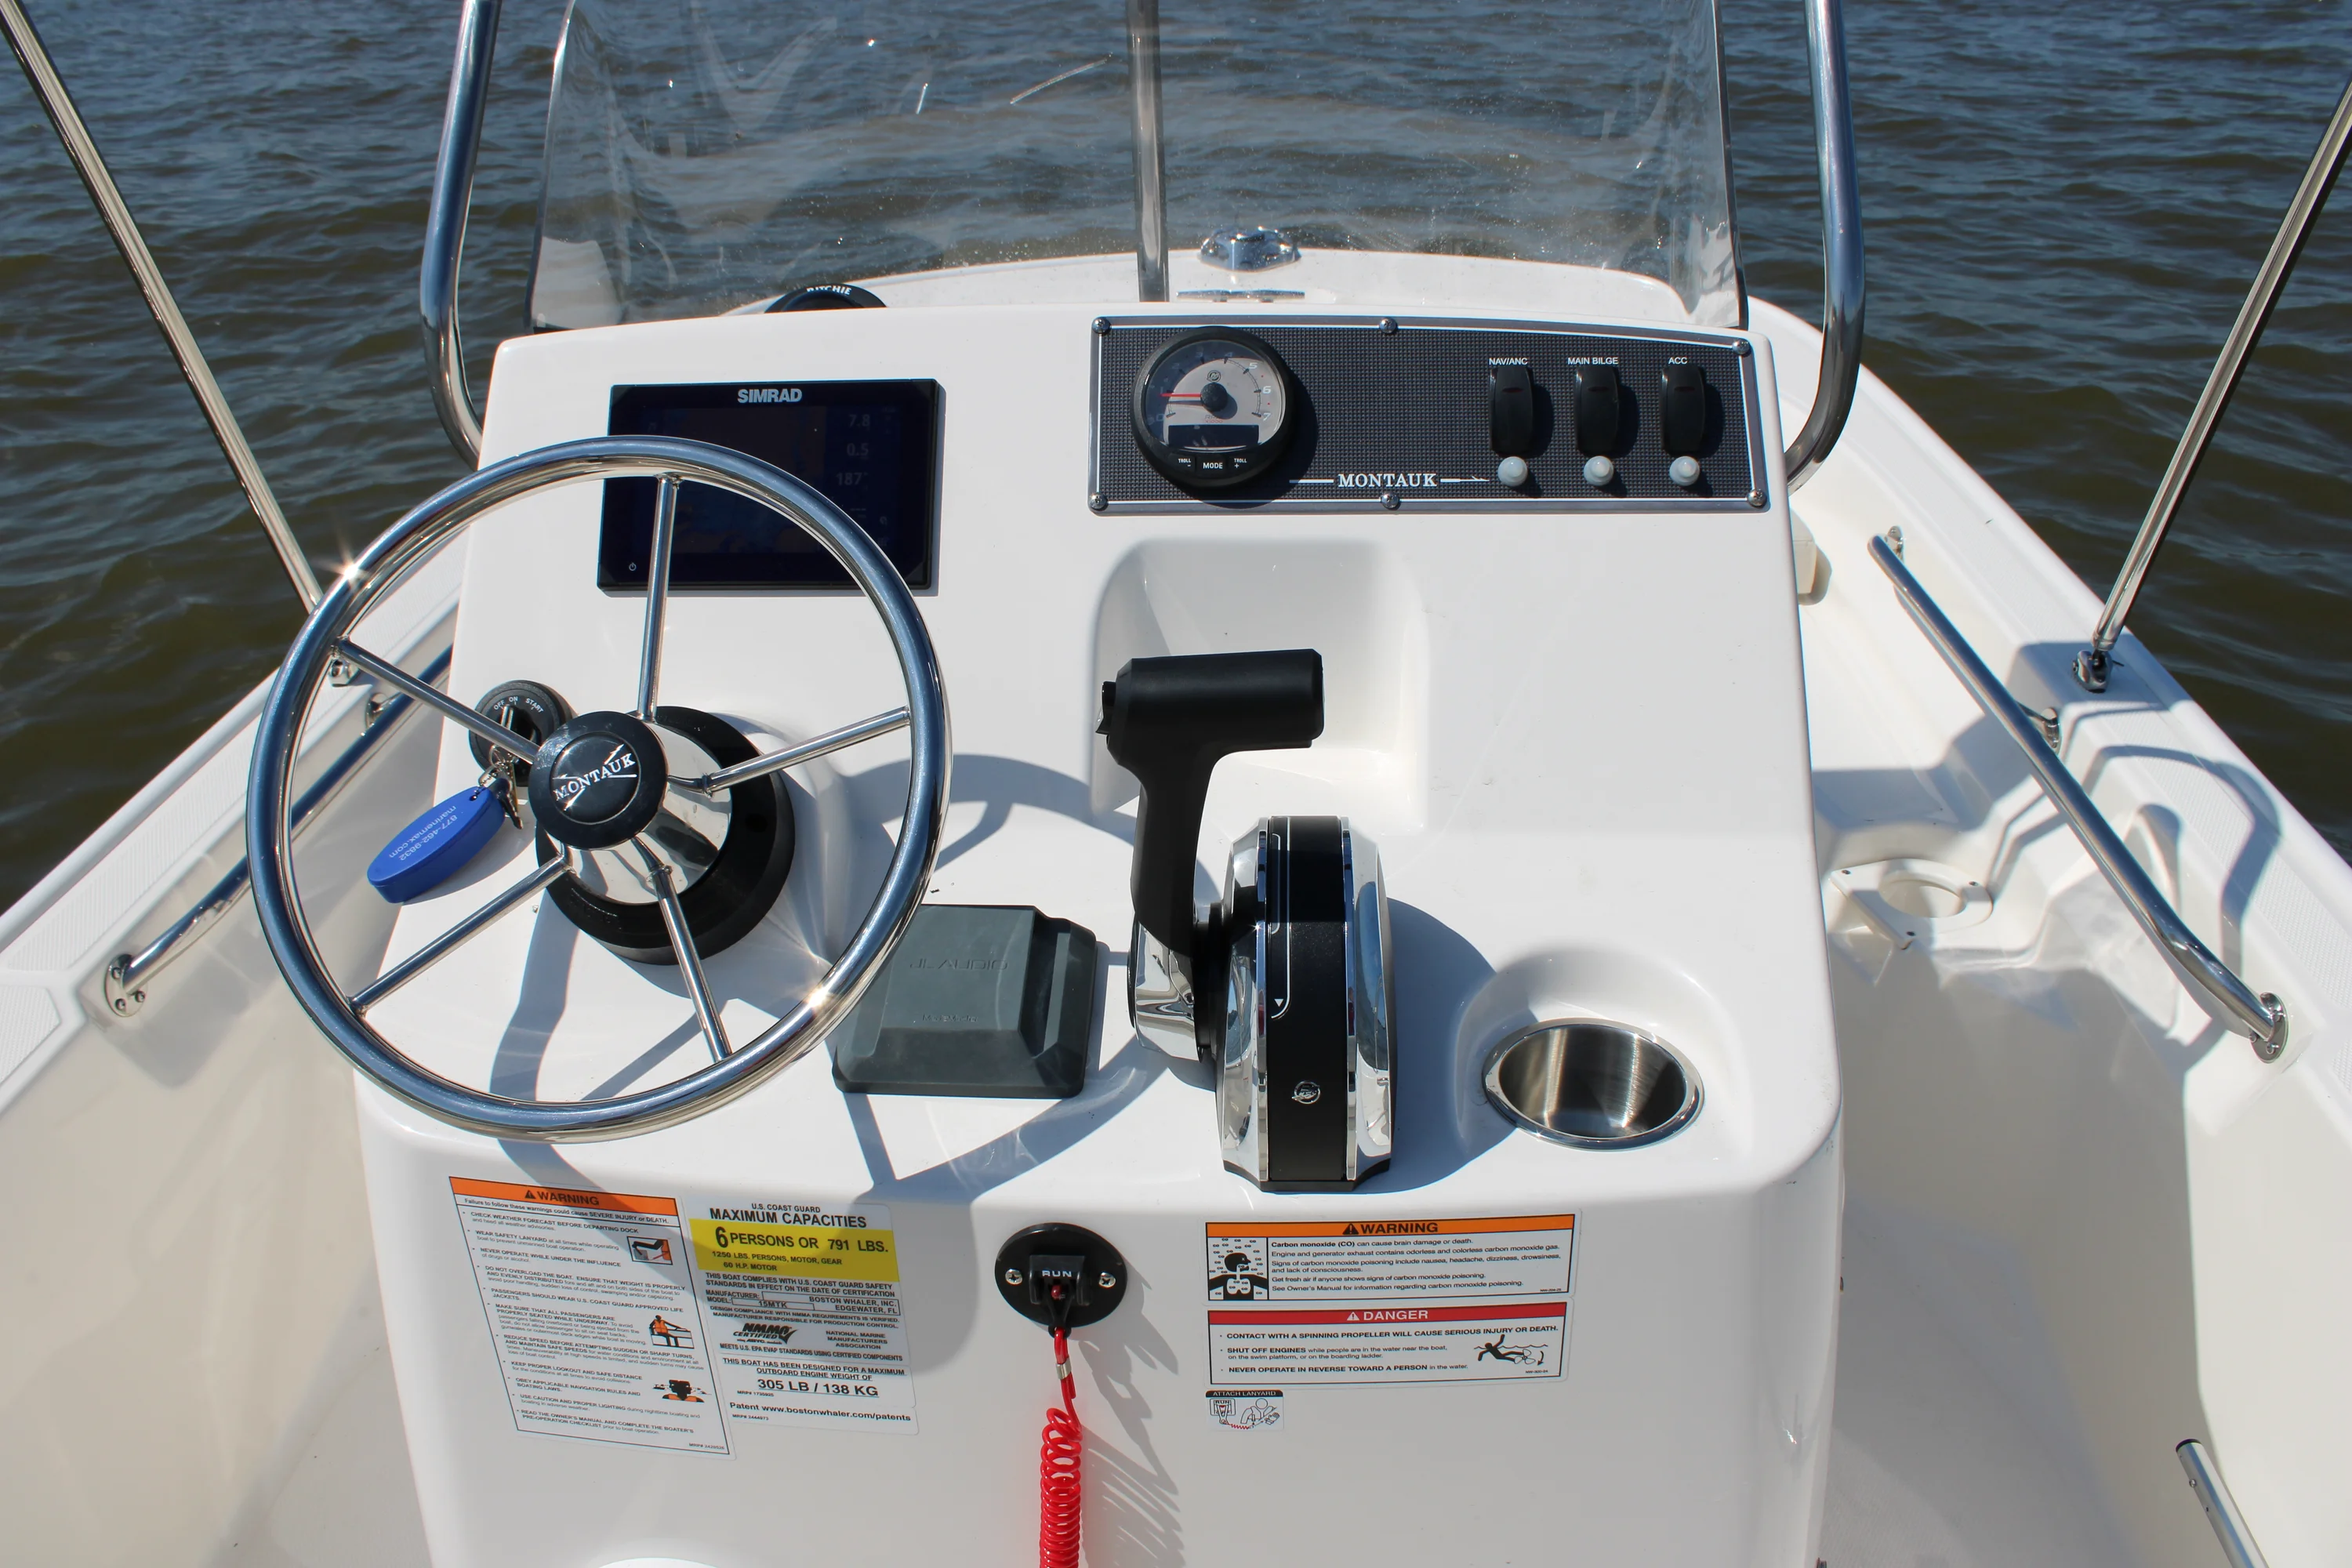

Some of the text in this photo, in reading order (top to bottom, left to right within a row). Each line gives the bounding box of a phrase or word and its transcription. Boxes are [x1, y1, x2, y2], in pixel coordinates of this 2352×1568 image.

[737, 388, 802, 404] SIMRAD
[1338, 473, 1437, 487] MONTAUK
[494, 700, 505, 710] OFF
[526, 698, 544, 713] START
[554, 753, 636, 801] MONTAUK
[389, 806, 457, 858] marinemax.com
[399, 815, 458, 861] 877-462-9832
[537, 1191, 599, 1205] WARNING
[709, 1208, 867, 1227] MAXIMUM CAPACITIES
[1360, 1222, 1438, 1234] WARNING
[715, 1226, 889, 1252] 6 PERSONS OR 791 LBS.
[751, 1254, 789, 1262] PERSONS,
[790, 1256, 819, 1264] MOTOR,
[706, 1280, 747, 1288] STANDARDS
[842, 1288, 895, 1297] CERTIFICATION
[706, 1289, 760, 1299] MANUFACTURER:
[809, 1296, 841, 1304] BOSTON
[843, 1298, 879, 1307] WHALER,
[759, 1300, 788, 1309] 15MTK
[835, 1305, 886, 1314] EDGEWATER,
[1363, 1310, 1428, 1321] DANGER
[733, 1331, 780, 1340] CERTIFIED
[827, 1336, 888, 1344] MANUFACTURERS
[758, 1379, 877, 1395] 305 LB / 138 KG
[730, 1403, 759, 1411] Patent
[761, 1405, 911, 1423] www.bostonwhaler.com/patents
